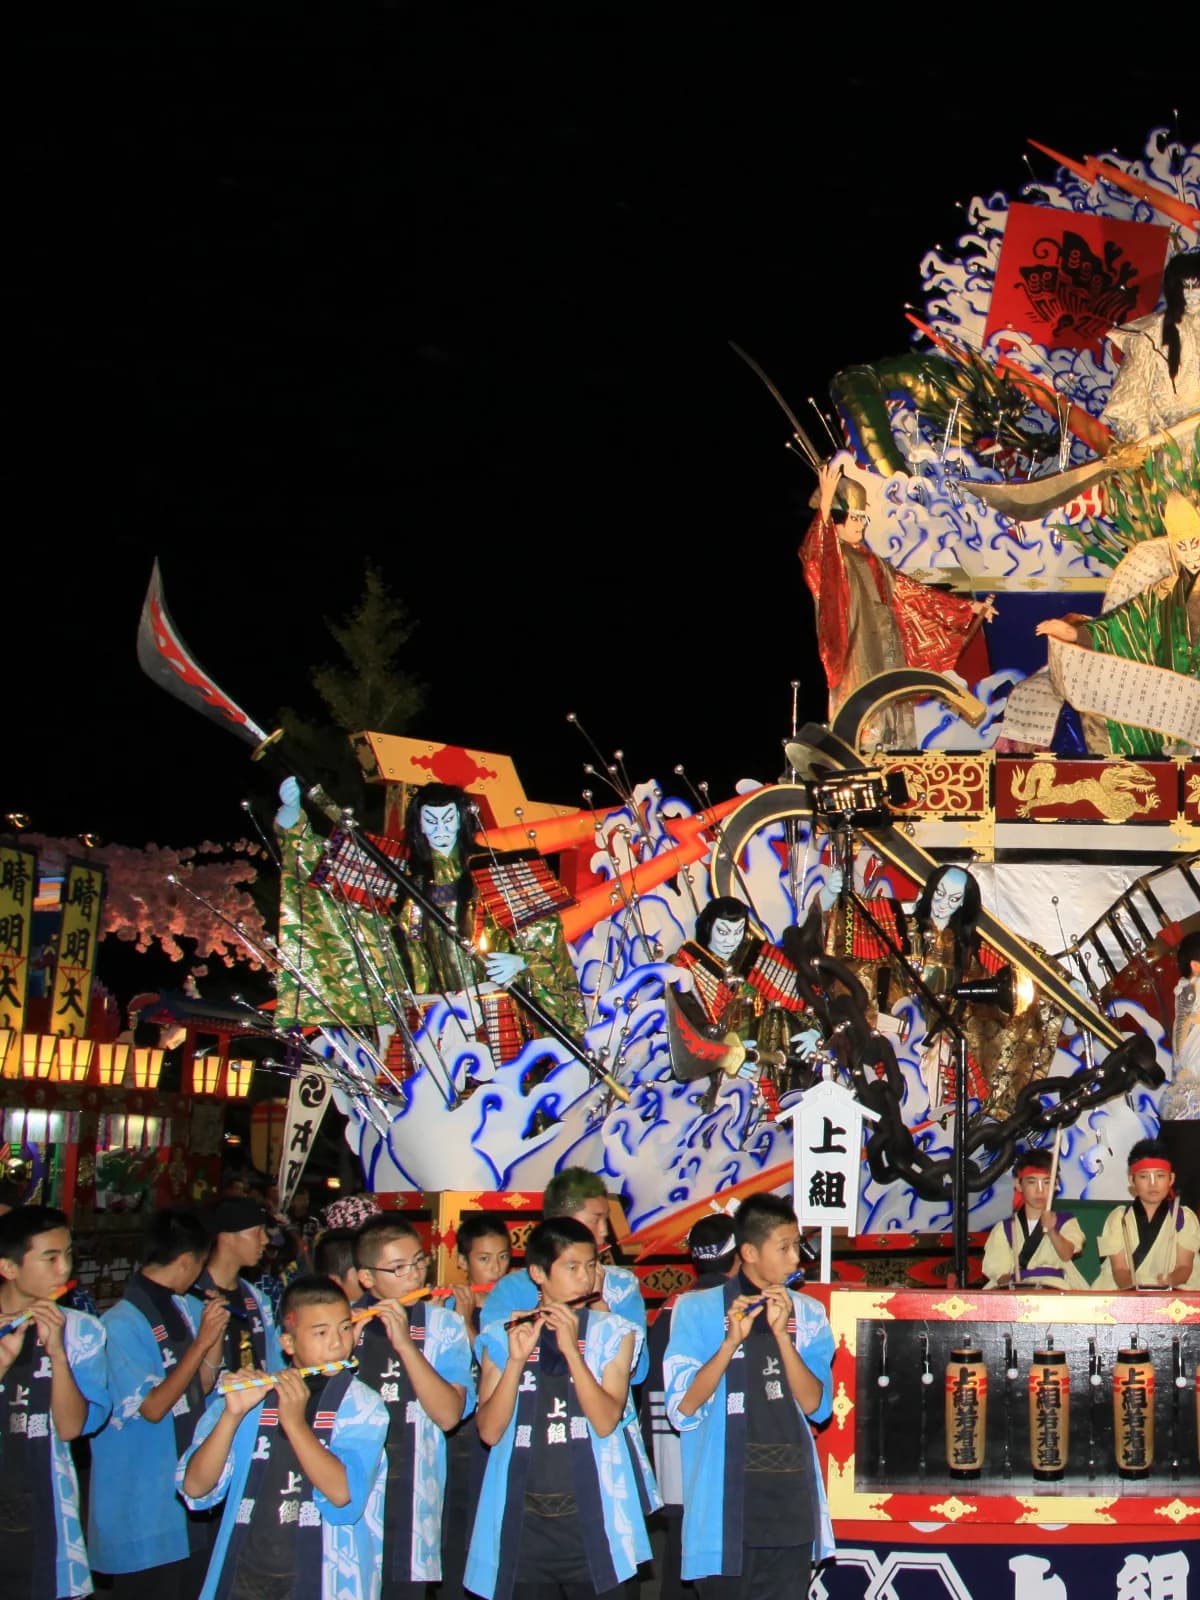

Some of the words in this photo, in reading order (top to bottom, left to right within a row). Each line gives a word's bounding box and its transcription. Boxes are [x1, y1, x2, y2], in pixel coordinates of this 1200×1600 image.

[0, 853, 31, 1030] 晴明大
[56, 872, 99, 1038] 晴明大
[809, 1116, 847, 1209] 上組
[763, 1355, 784, 1400] 上組
[547, 1397, 567, 1445] 上組
[279, 1471, 302, 1524] 上組
